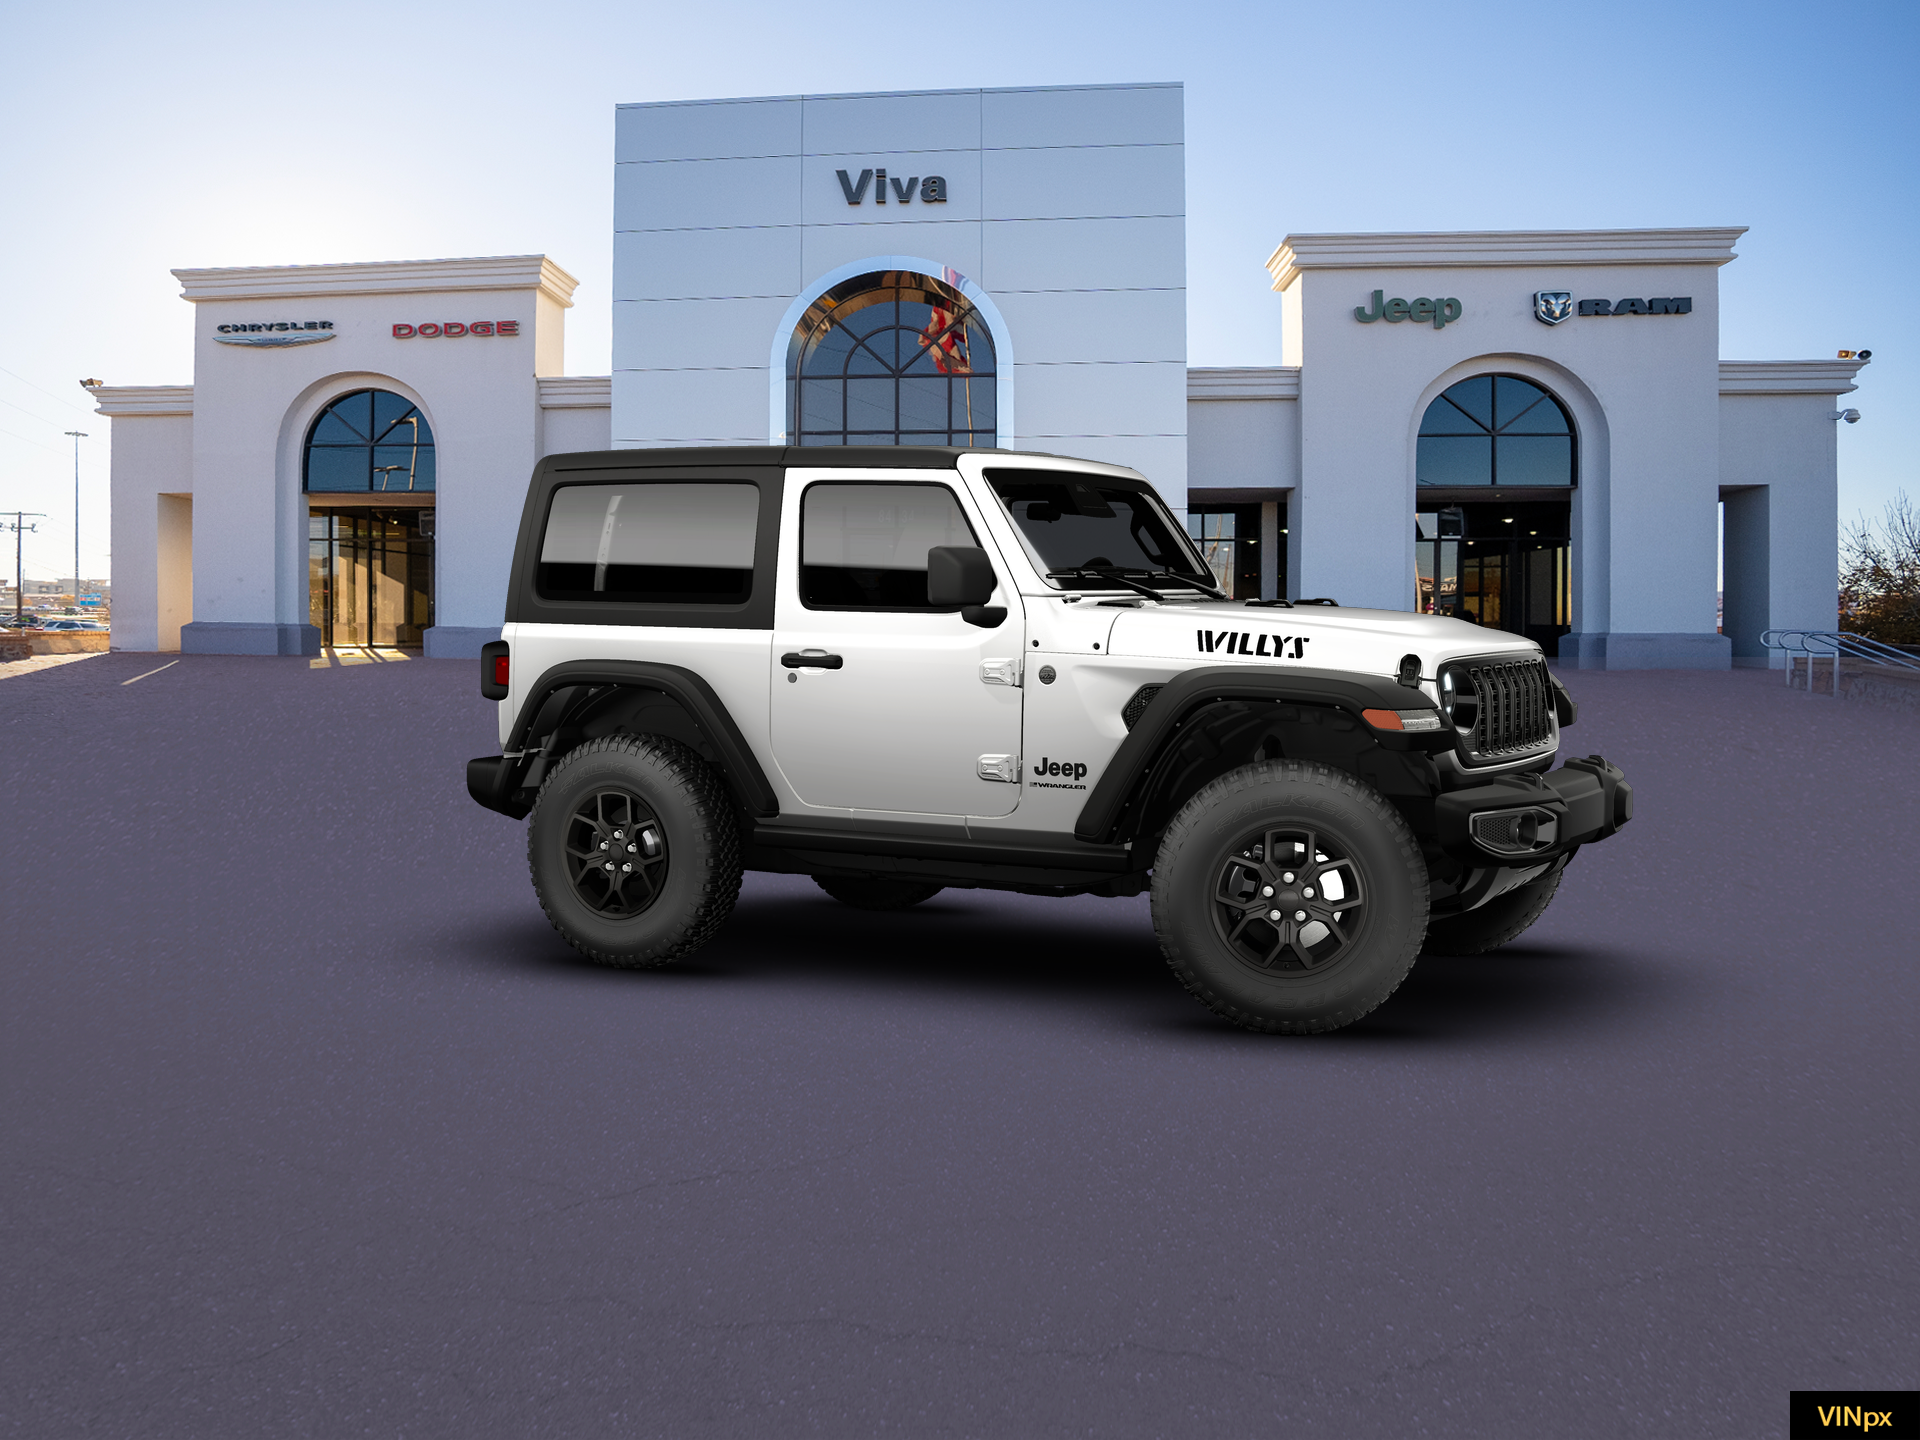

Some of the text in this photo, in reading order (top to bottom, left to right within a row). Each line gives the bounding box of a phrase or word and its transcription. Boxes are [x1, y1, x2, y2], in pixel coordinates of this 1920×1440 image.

[835, 168, 947, 205] Viva
[1354, 289, 1462, 329] Jeep
[1578, 297, 1692, 316] RAM
[217, 321, 334, 333] CHRYSLER
[392, 319, 520, 339] DODGE
[1197, 629, 1310, 659] WILLYS
[558, 761, 664, 795] FALKEN
[1033, 757, 1087, 781] Jeep
[1037, 781, 1087, 790] WRANGLER
[1211, 792, 1366, 836] FALKEN
